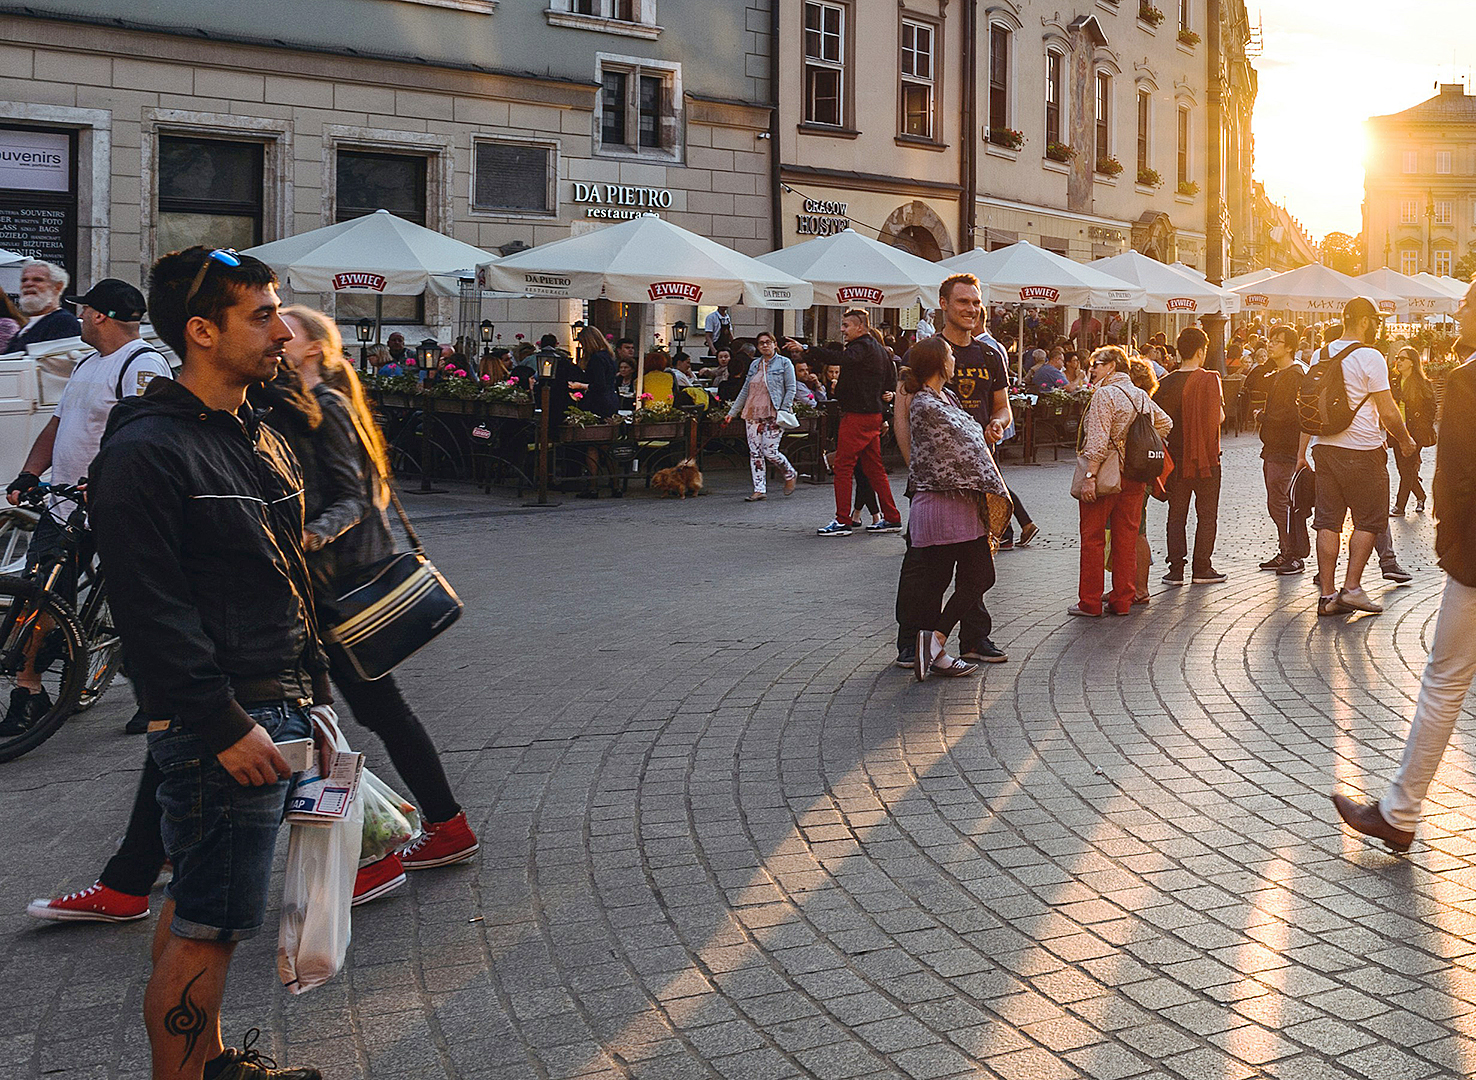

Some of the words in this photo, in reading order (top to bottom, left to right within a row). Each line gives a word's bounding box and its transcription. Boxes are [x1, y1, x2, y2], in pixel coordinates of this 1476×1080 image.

[0, 151, 61, 164] uvenirs
[574, 183, 602, 203] DA
[606, 185, 673, 208] PIETRO
[20, 209, 65, 218] SOUVENIRS
[587, 207, 660, 220] restauraa
[804, 199, 848, 215] CRACOW
[42, 218, 63, 226] FOTO
[38, 225, 60, 233] BAGS
[340, 273, 381, 287] ŻYWIEC
[525, 274, 538, 283] DA
[540, 275, 571, 287] PIETRO
[524, 287, 570, 296] RESTAURACJA
[655, 283, 697, 298] ŻYWIEC
[843, 287, 879, 300] ŻYWIEC
[1024, 287, 1056, 299] ŻYWIEC
[1307, 300, 1334, 309] MAX
